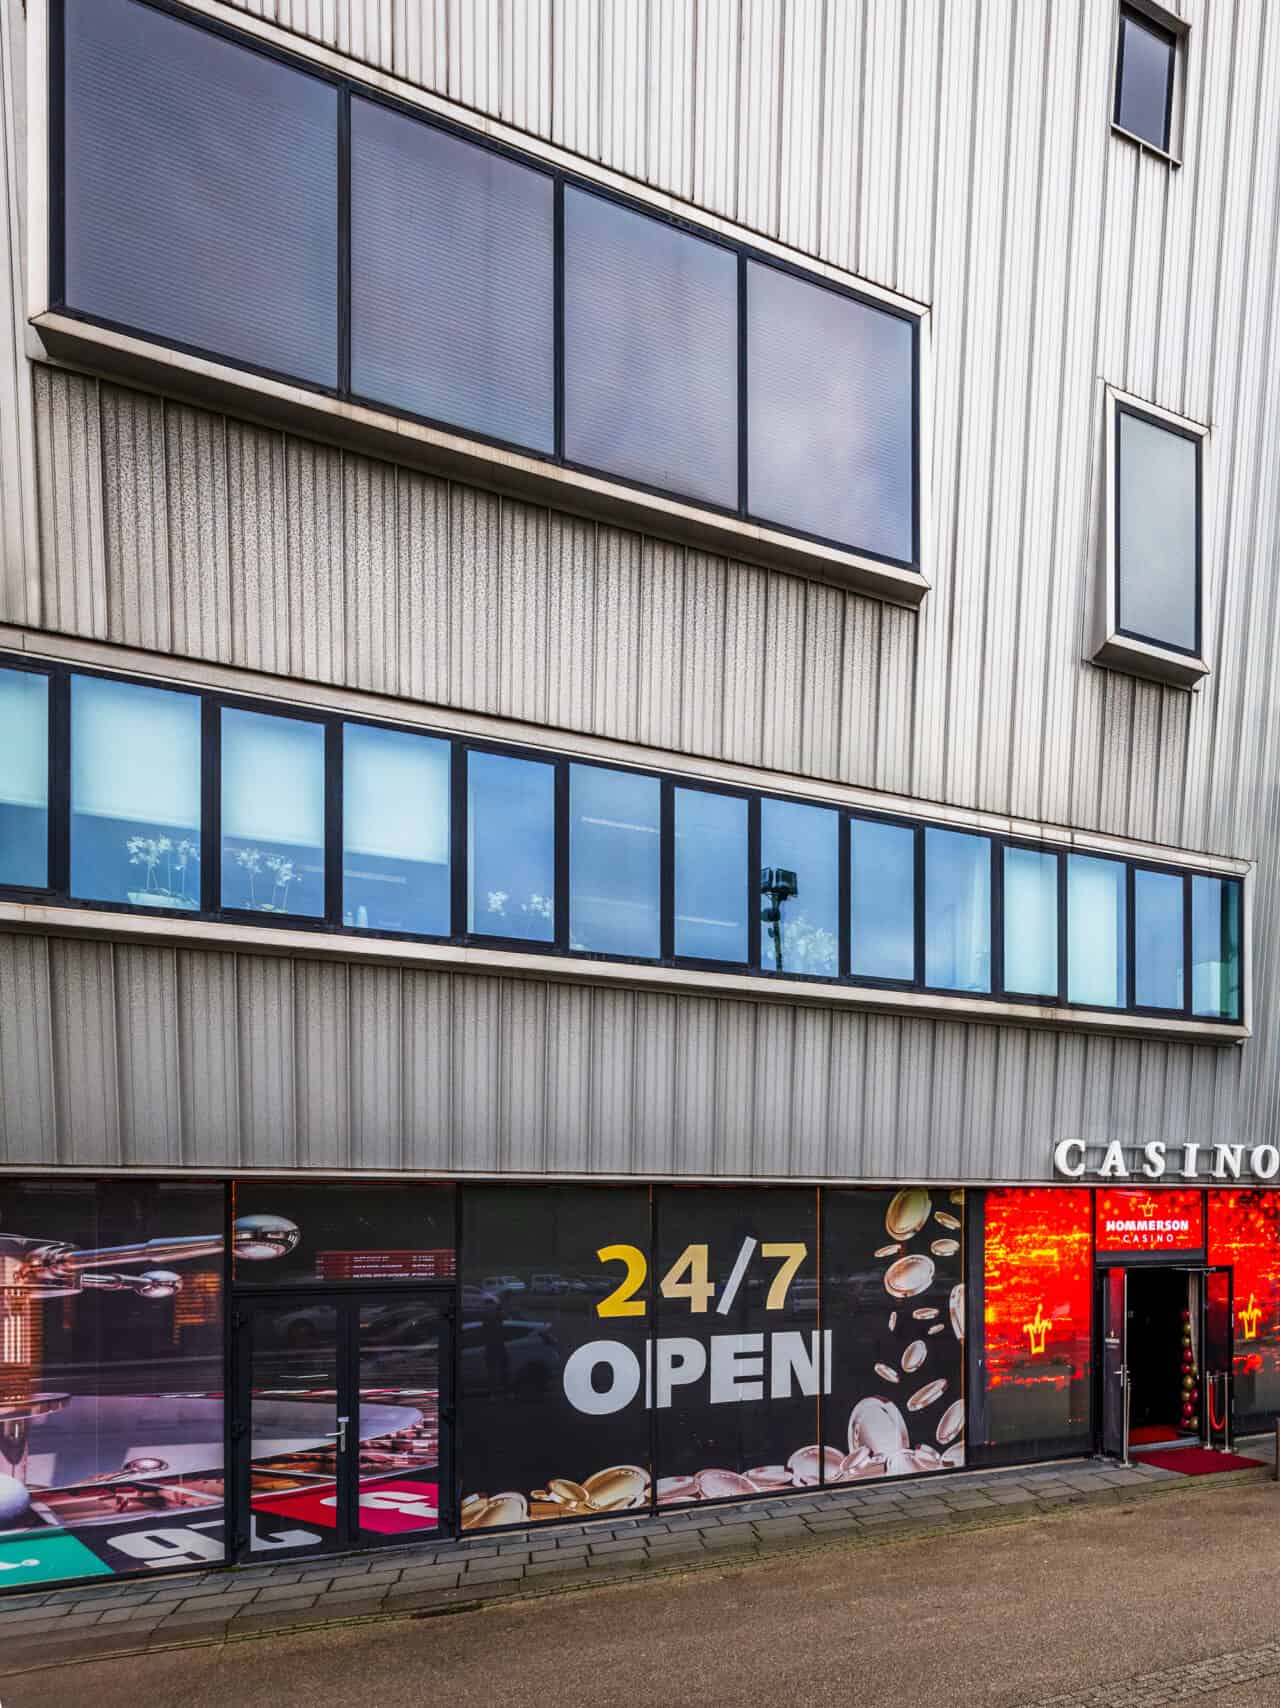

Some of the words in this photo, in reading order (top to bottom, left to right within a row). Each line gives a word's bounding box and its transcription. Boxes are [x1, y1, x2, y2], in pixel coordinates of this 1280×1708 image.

[1054, 1138, 1280, 1179] CASINO
[1105, 1219, 1190, 1232] HOMMERSON
[1122, 1233, 1175, 1243] CASINO
[596, 1236, 809, 1318] 24/7
[563, 1329, 832, 1415] OPEN
